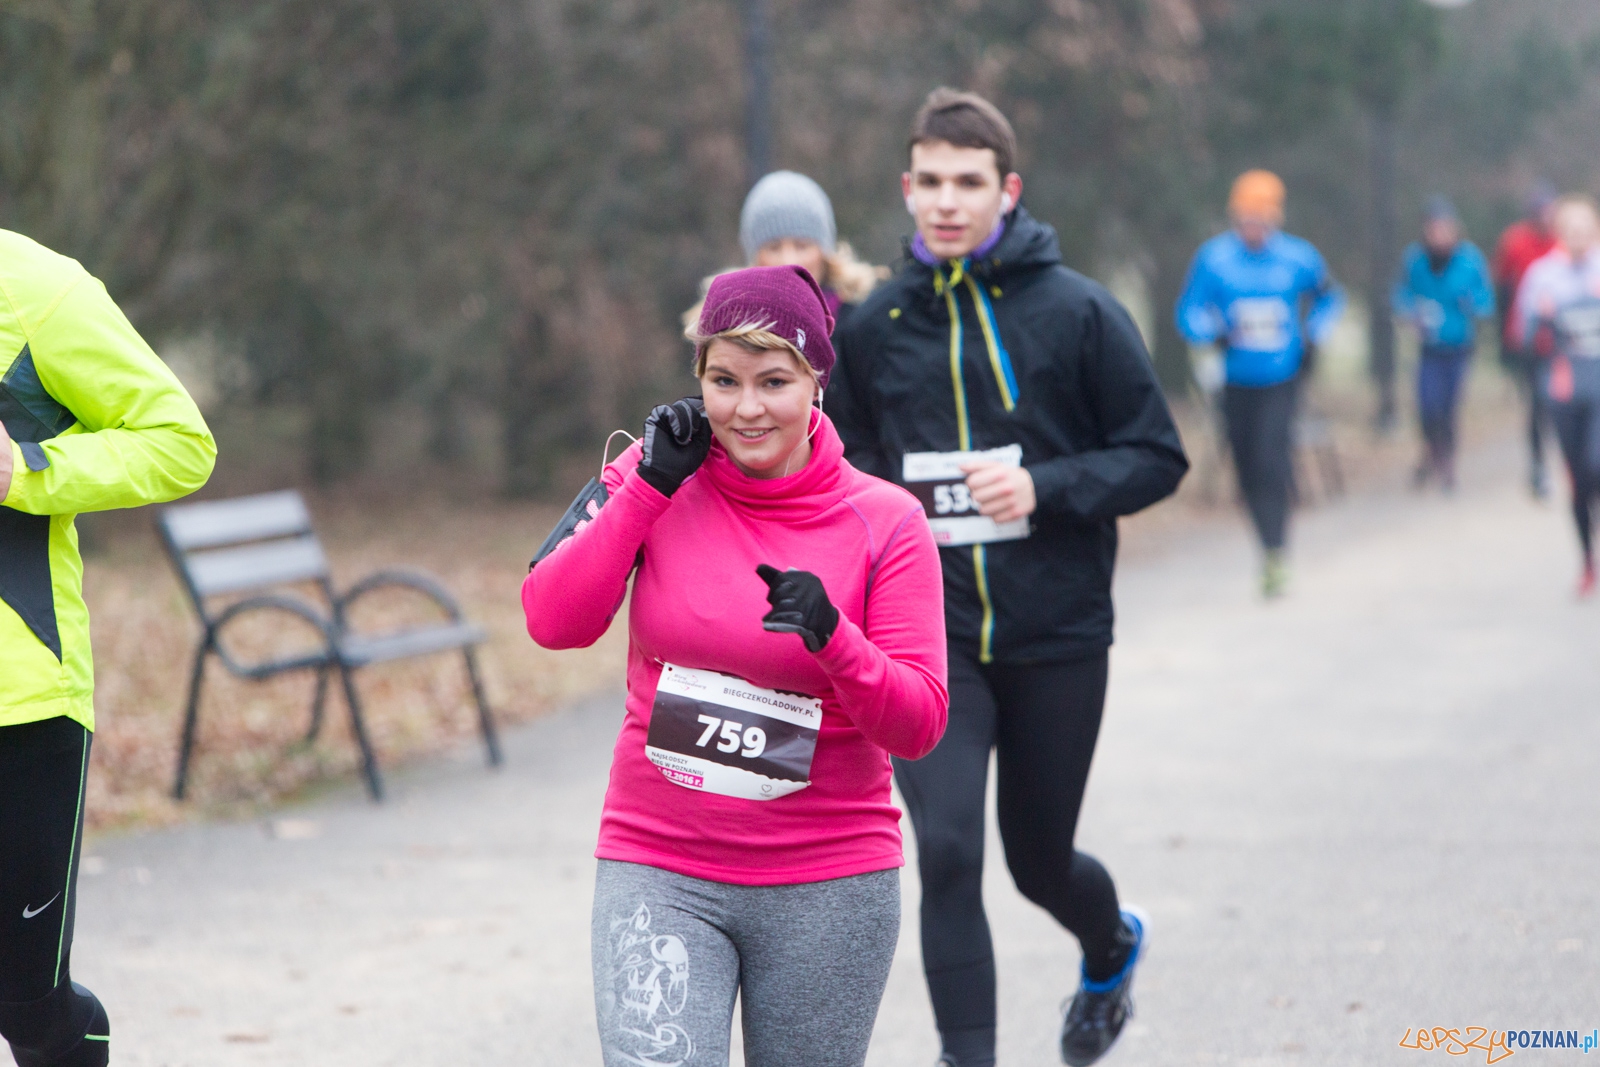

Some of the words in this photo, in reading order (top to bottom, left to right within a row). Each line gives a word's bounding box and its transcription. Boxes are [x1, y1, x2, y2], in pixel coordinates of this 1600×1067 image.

[723, 687, 815, 718] BIEGCZEKOLADOWY.PL
[695, 713, 767, 759] 759
[671, 764, 704, 776] POZNANIU
